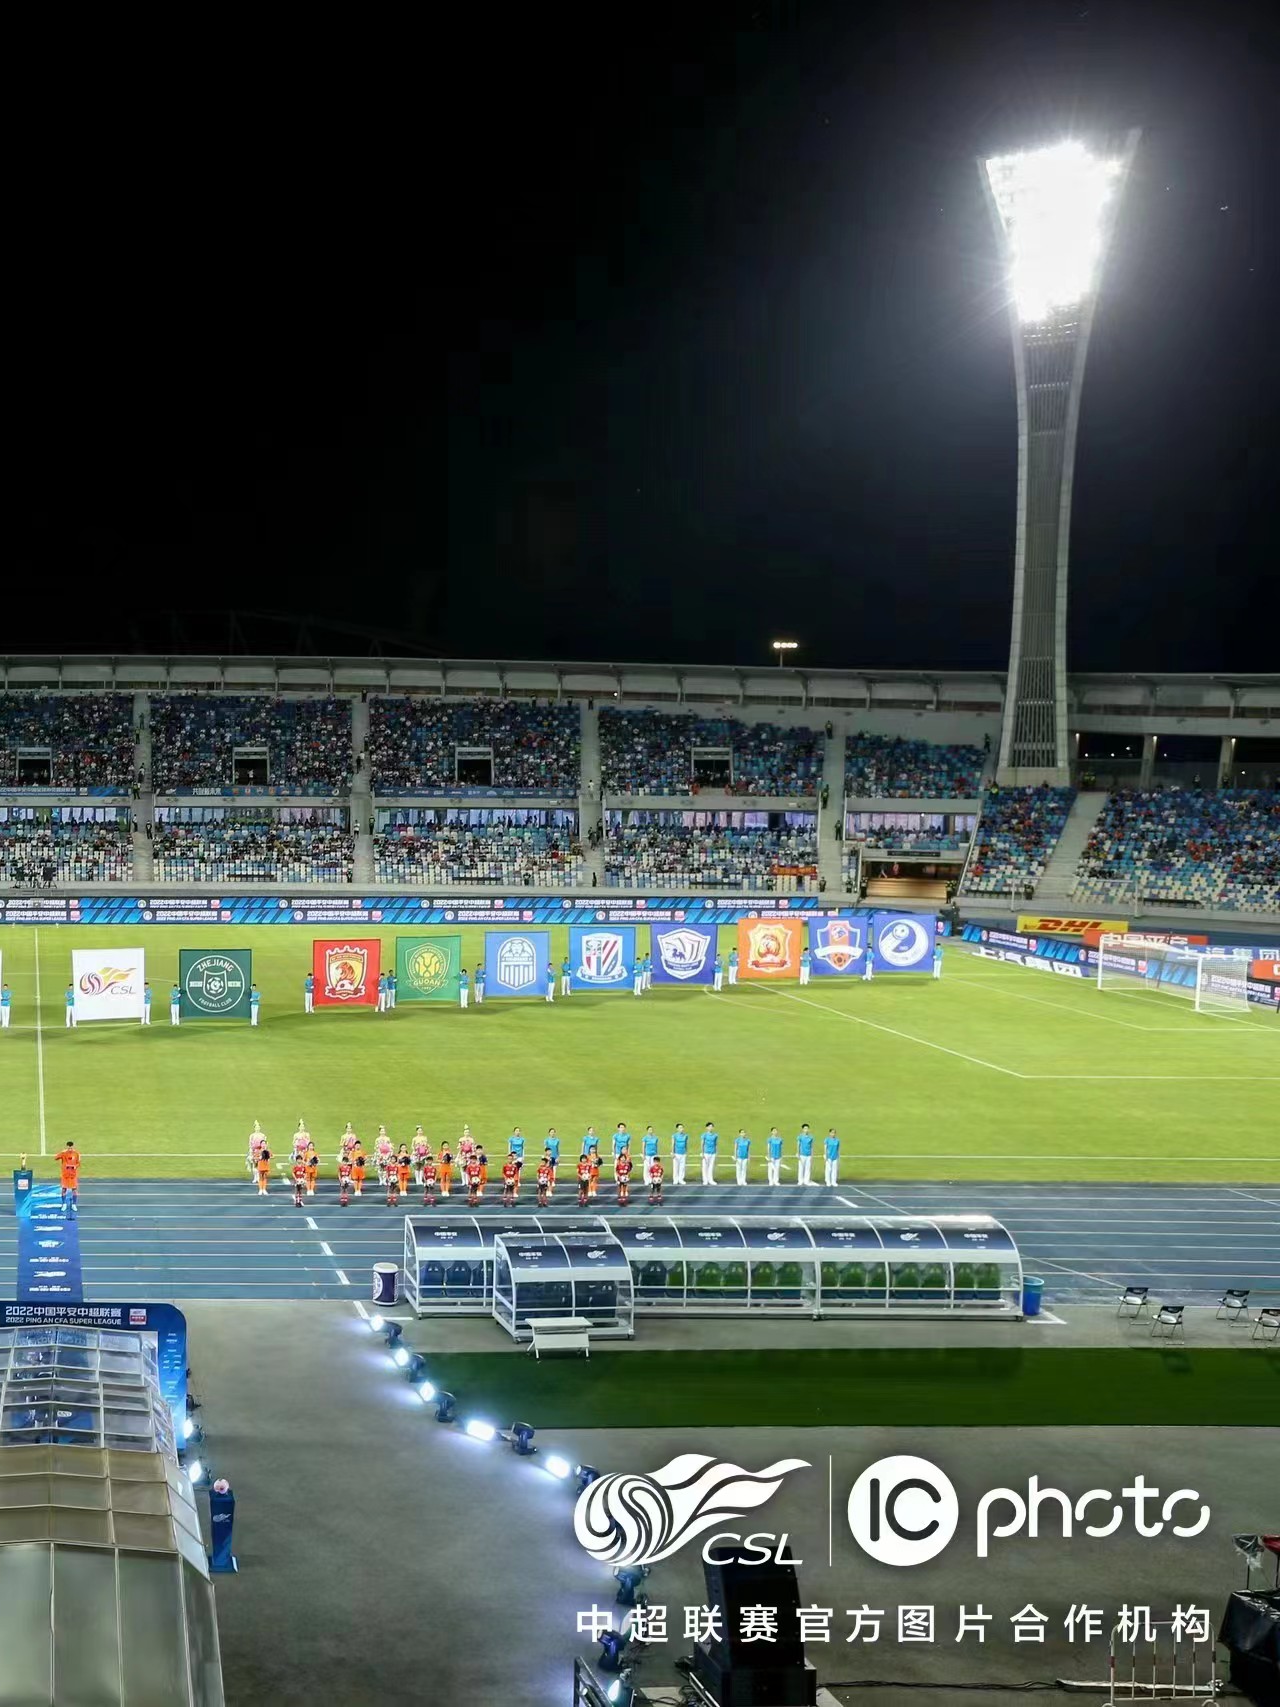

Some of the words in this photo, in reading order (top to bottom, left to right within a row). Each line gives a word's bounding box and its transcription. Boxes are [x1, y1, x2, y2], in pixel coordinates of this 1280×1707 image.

[1037, 918, 1102, 931] DHL
[196, 958, 235, 972] ZHEJIANG
[110, 985, 136, 995] CSL
[5, 1306, 122, 1317] 2022中国平安中超联赛
